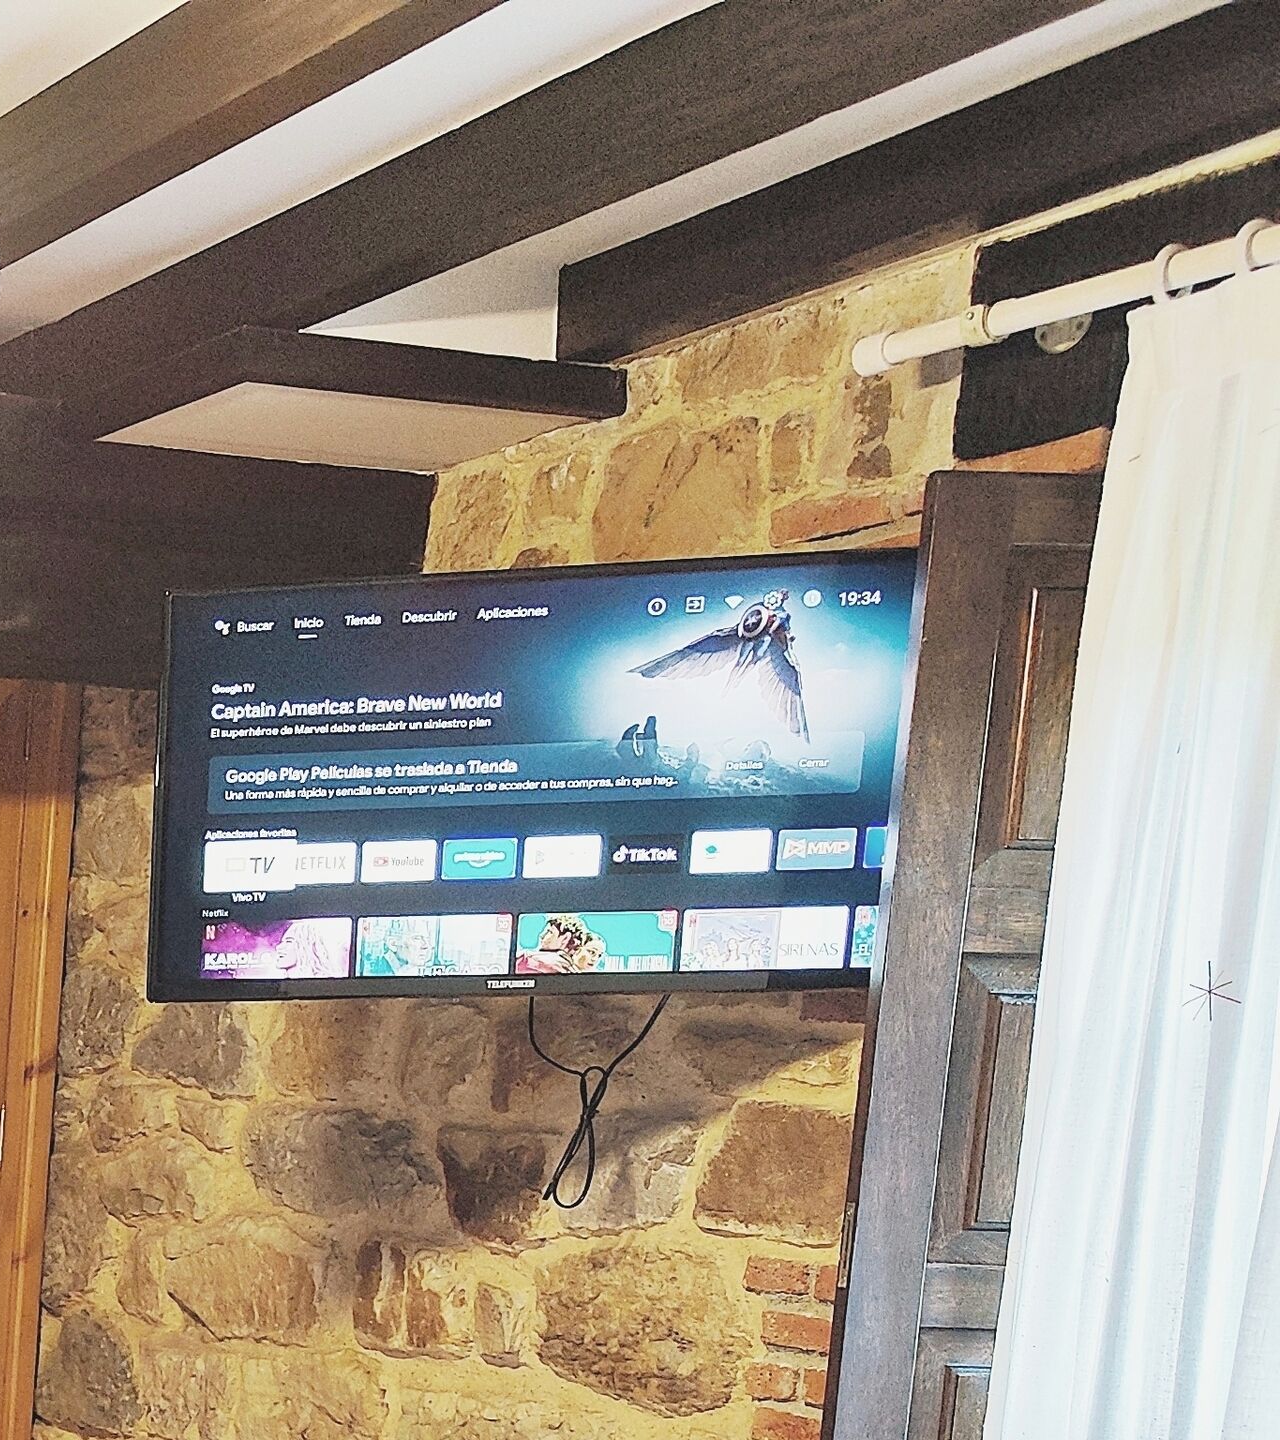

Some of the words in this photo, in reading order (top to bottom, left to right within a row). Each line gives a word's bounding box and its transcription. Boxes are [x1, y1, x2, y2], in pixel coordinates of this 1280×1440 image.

[839, 590, 882, 606] 19:34
[345, 614, 382, 626] Tienda
[402, 609, 458, 624] Descubrir
[476, 605, 549, 621] Aplicaciones
[237, 620, 275, 633] Buscar
[294, 617, 324, 629] Inicio
[212, 684, 242, 695] Google
[243, 683, 255, 693] TV
[211, 702, 275, 722] Captain
[278, 698, 354, 717] America:
[357, 696, 405, 713] Brave
[408, 694, 448, 711] New
[450, 692, 502, 709] World
[211, 727, 220, 738] El
[280, 725, 293, 735] de
[294, 724, 329, 734] Marvel
[330, 723, 357, 733] debe
[358, 720, 408, 732] descubrir
[409, 721, 422, 730] un
[423, 719, 468, 729] siniestro
[469, 717, 492, 730] plan
[726, 760, 764, 770] Detalles
[799, 758, 830, 768] Cerrar
[225, 767, 277, 785] Google
[279, 766, 310, 784] Play
[311, 764, 373, 780] Películas
[374, 765, 392, 778] se
[393, 761, 453, 777] traslada
[454, 764, 466, 776] a
[467, 758, 518, 775] Tienda
[224, 790, 244, 800] Una
[245, 789, 274, 800] forma
[275, 788, 296, 799] más
[297, 787, 327, 799] rápida
[328, 788, 335, 798] y
[335, 785, 372, 796] sencilla
[373, 785, 386, 795] de
[387, 784, 430, 796] comprar
[430, 784, 437, 796] y
[438, 782, 474, 794] alquilar
[474, 783, 483, 792] o
[483, 781, 497, 791] de
[498, 780, 540, 791] acceder
[541, 781, 549, 789] a
[549, 780, 567, 788] tus
[567, 779, 614, 790] compras,
[614, 776, 631, 787] sin
[632, 777, 653, 788] que
[629, 848, 678, 862] TikTok
[808, 841, 851, 855] MMP
[250, 856, 275, 874] TV
[252, 892, 266, 902] TV
[202, 909, 229, 918] Netflix
